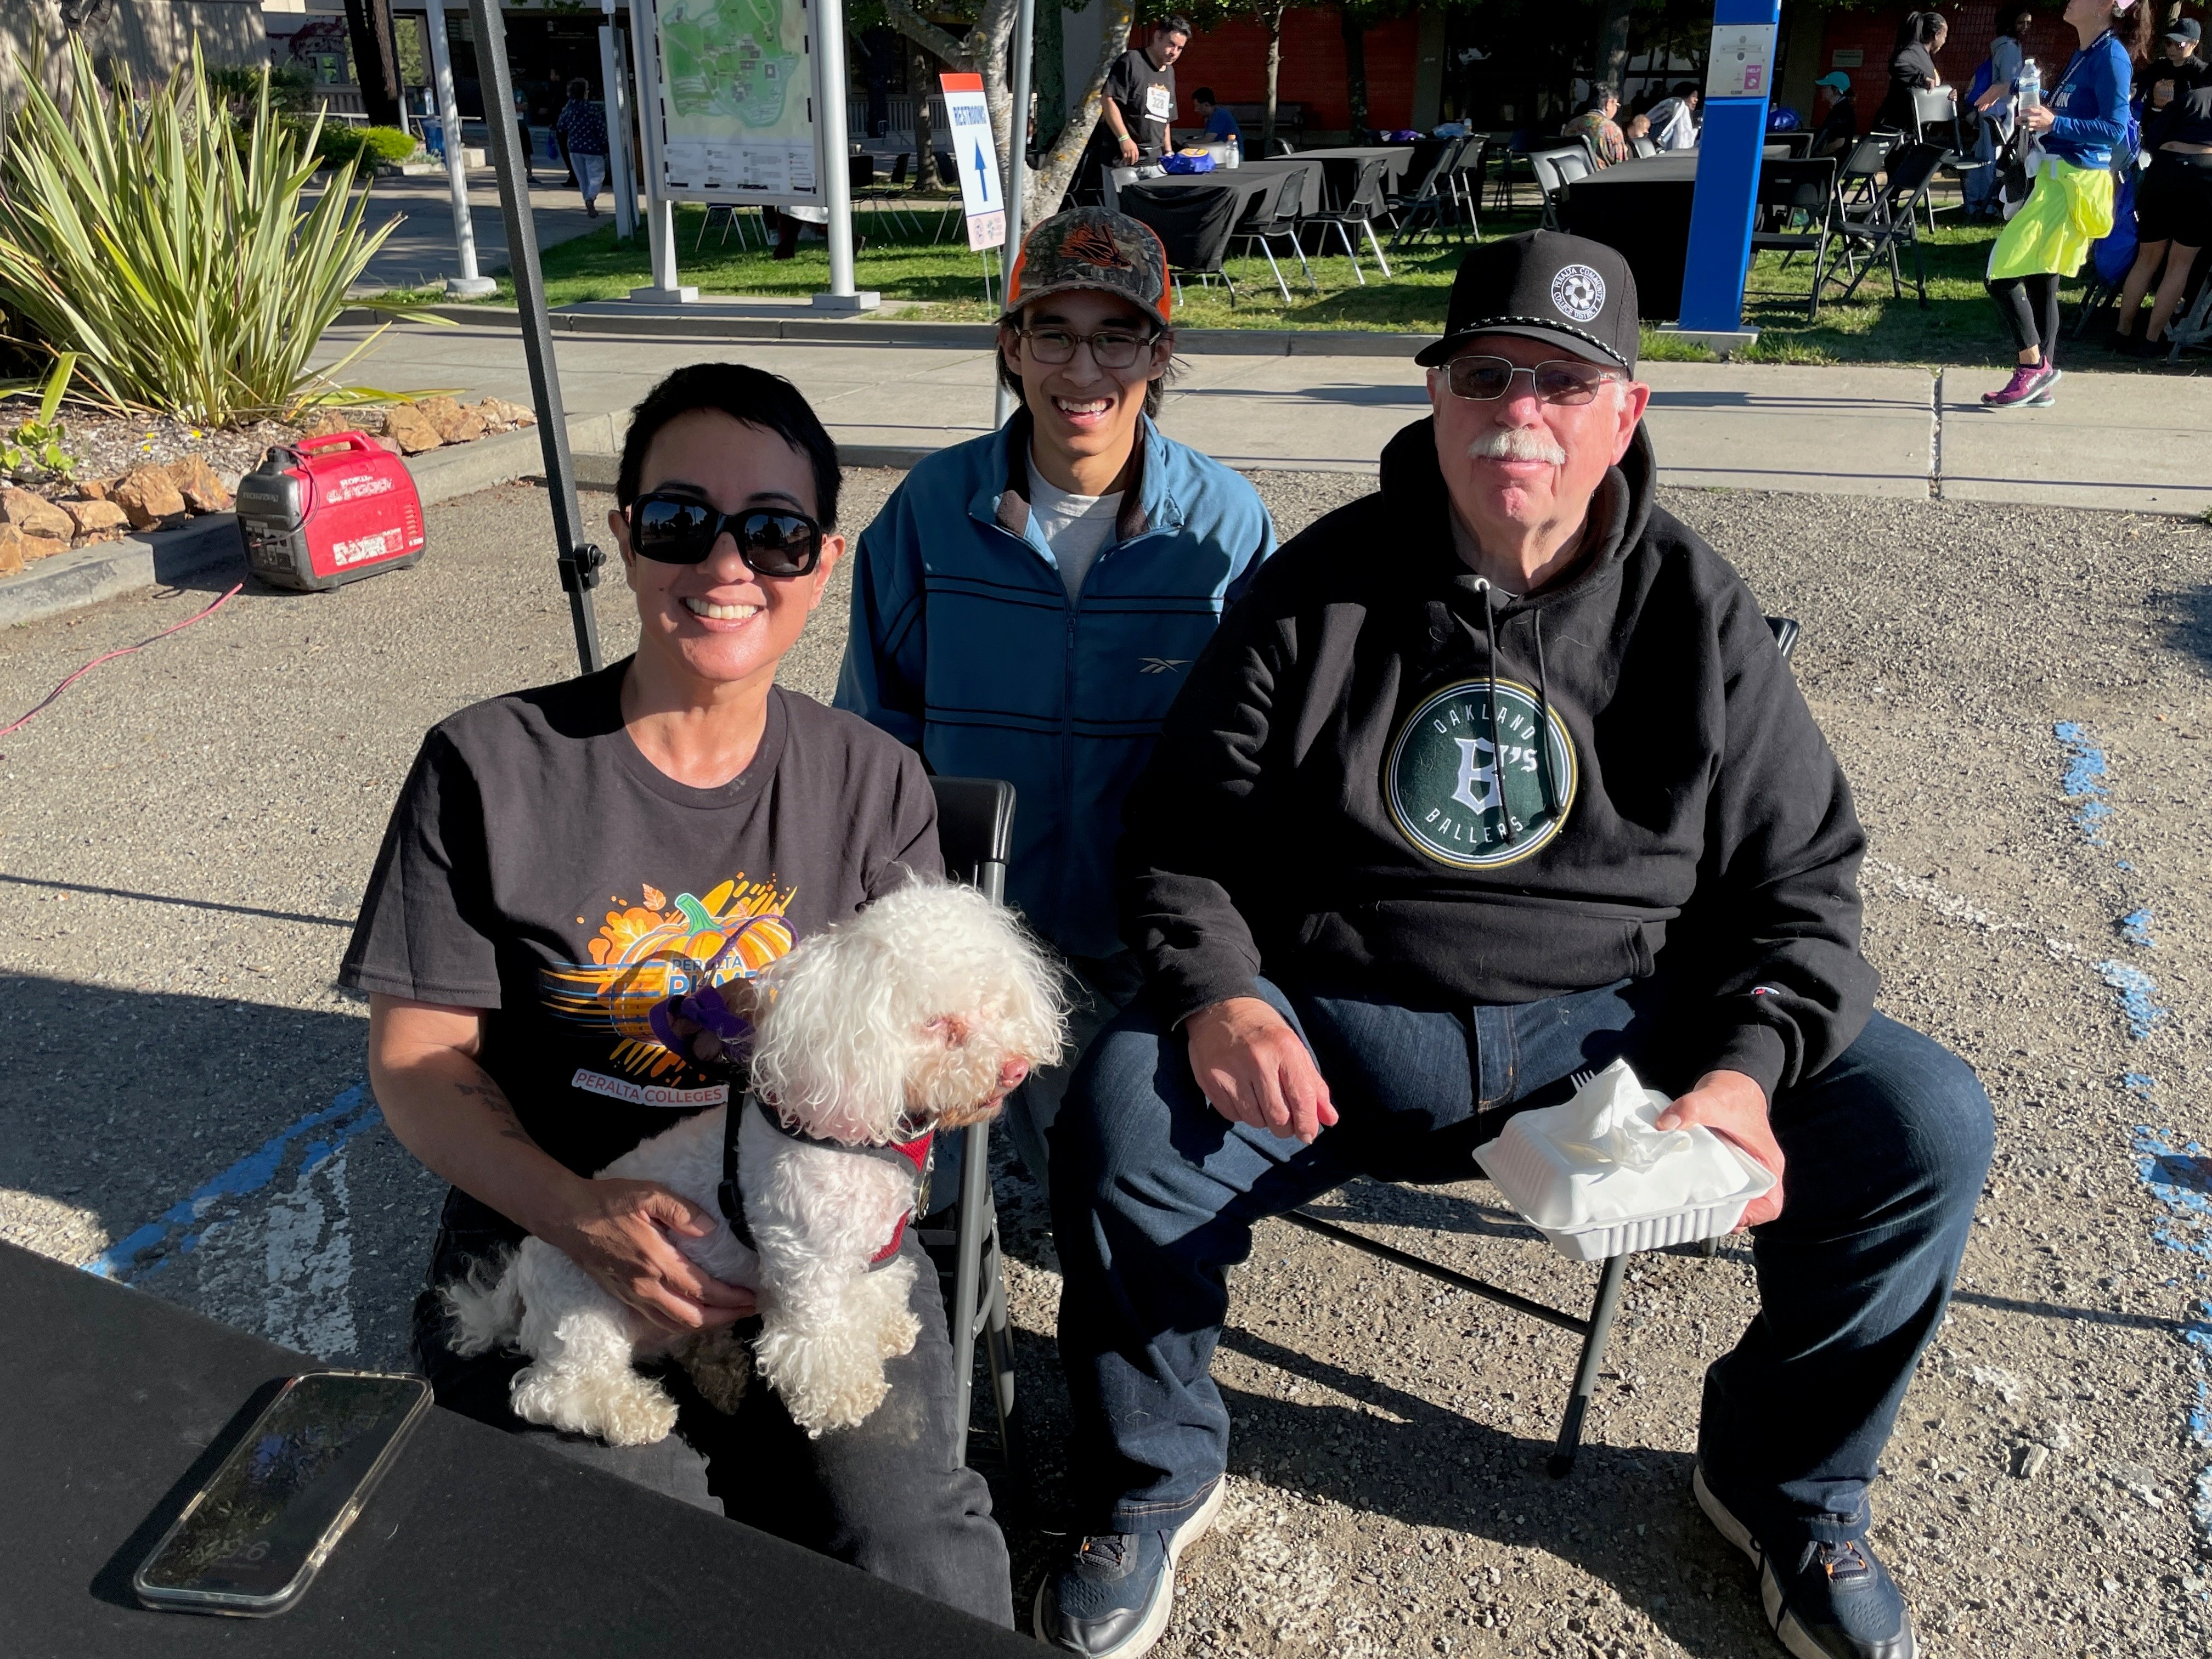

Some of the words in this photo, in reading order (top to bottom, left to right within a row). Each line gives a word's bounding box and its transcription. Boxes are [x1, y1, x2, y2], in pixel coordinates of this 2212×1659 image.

[952, 105, 986, 126] RESTROOMS
[1554, 267, 1577, 288] PERALTA
[1579, 267, 1603, 303] COMMUNITY
[1554, 292, 1574, 315] COLLEGE
[1574, 304, 1598, 319] DISTRICT
[1433, 703, 1536, 741] OAKLAND
[1425, 808, 1523, 844] BALLERS
[672, 956, 743, 972] PERTA
[575, 1072, 640, 1101] PERALTA
[645, 1088, 723, 1103] COLLEGES
